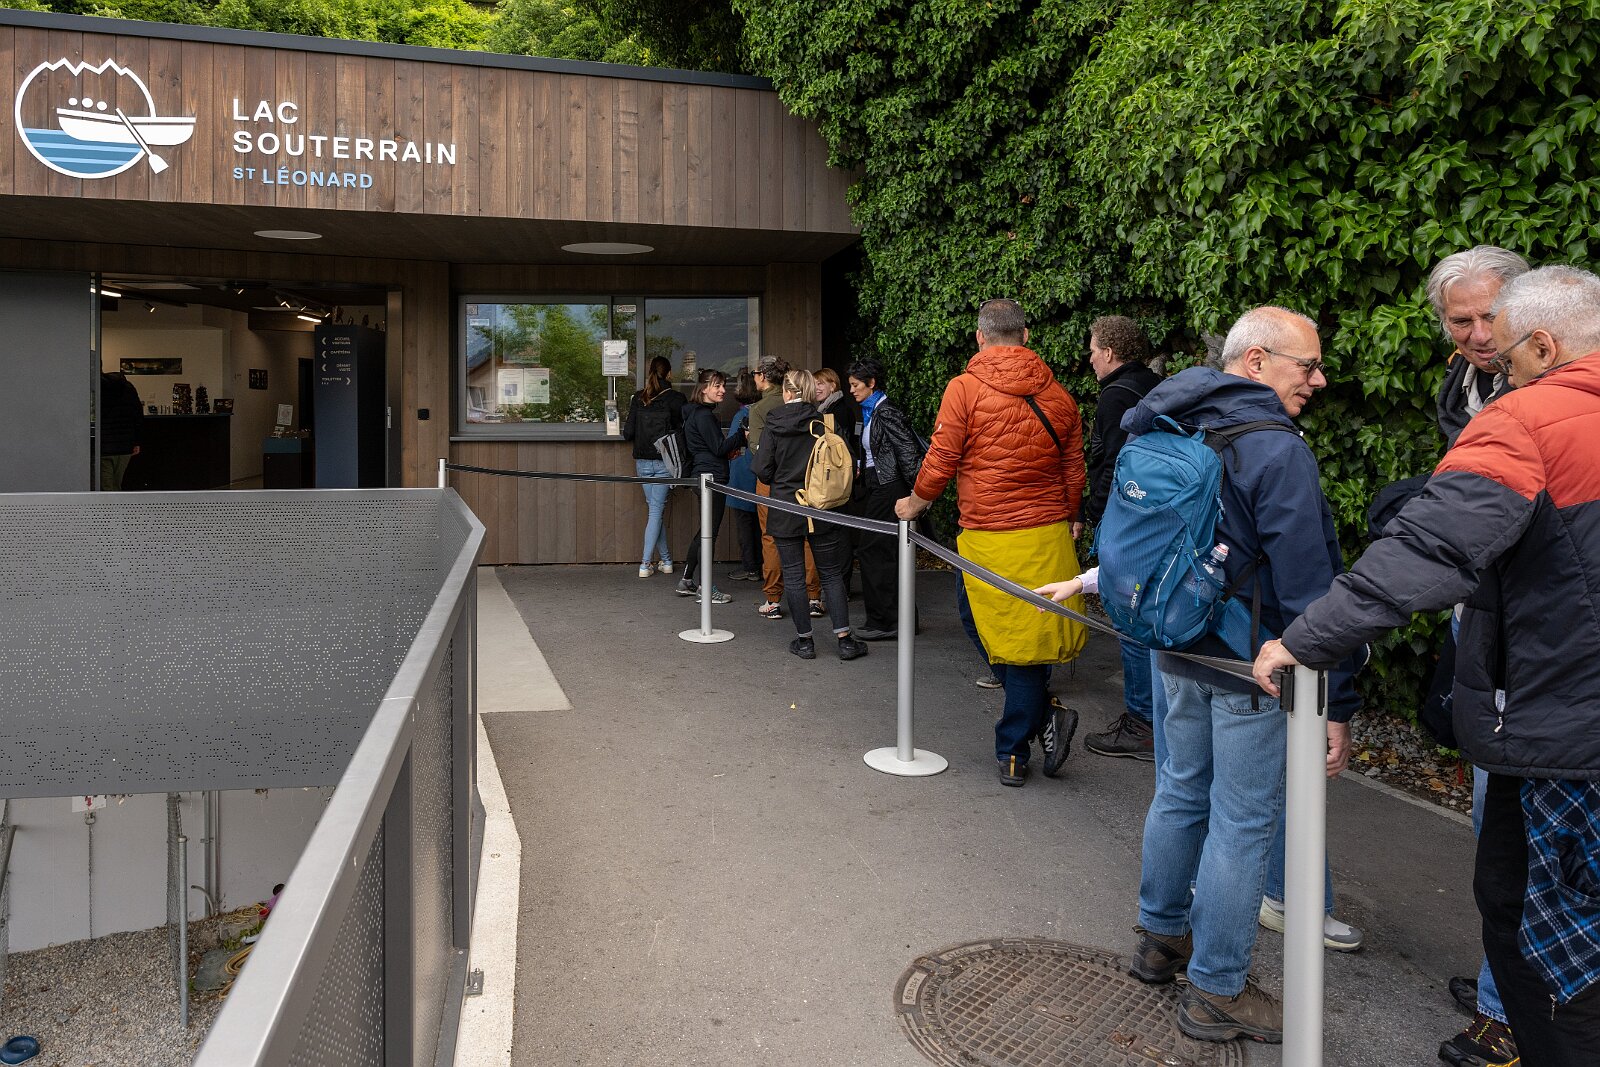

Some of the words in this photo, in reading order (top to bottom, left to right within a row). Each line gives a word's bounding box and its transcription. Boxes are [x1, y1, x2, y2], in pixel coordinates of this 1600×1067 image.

[233, 98, 298, 124] LAC
[233, 131, 456, 165] SOUTERRAIN
[233, 167, 256, 180] ST
[262, 166, 373, 189] LÉONARD
